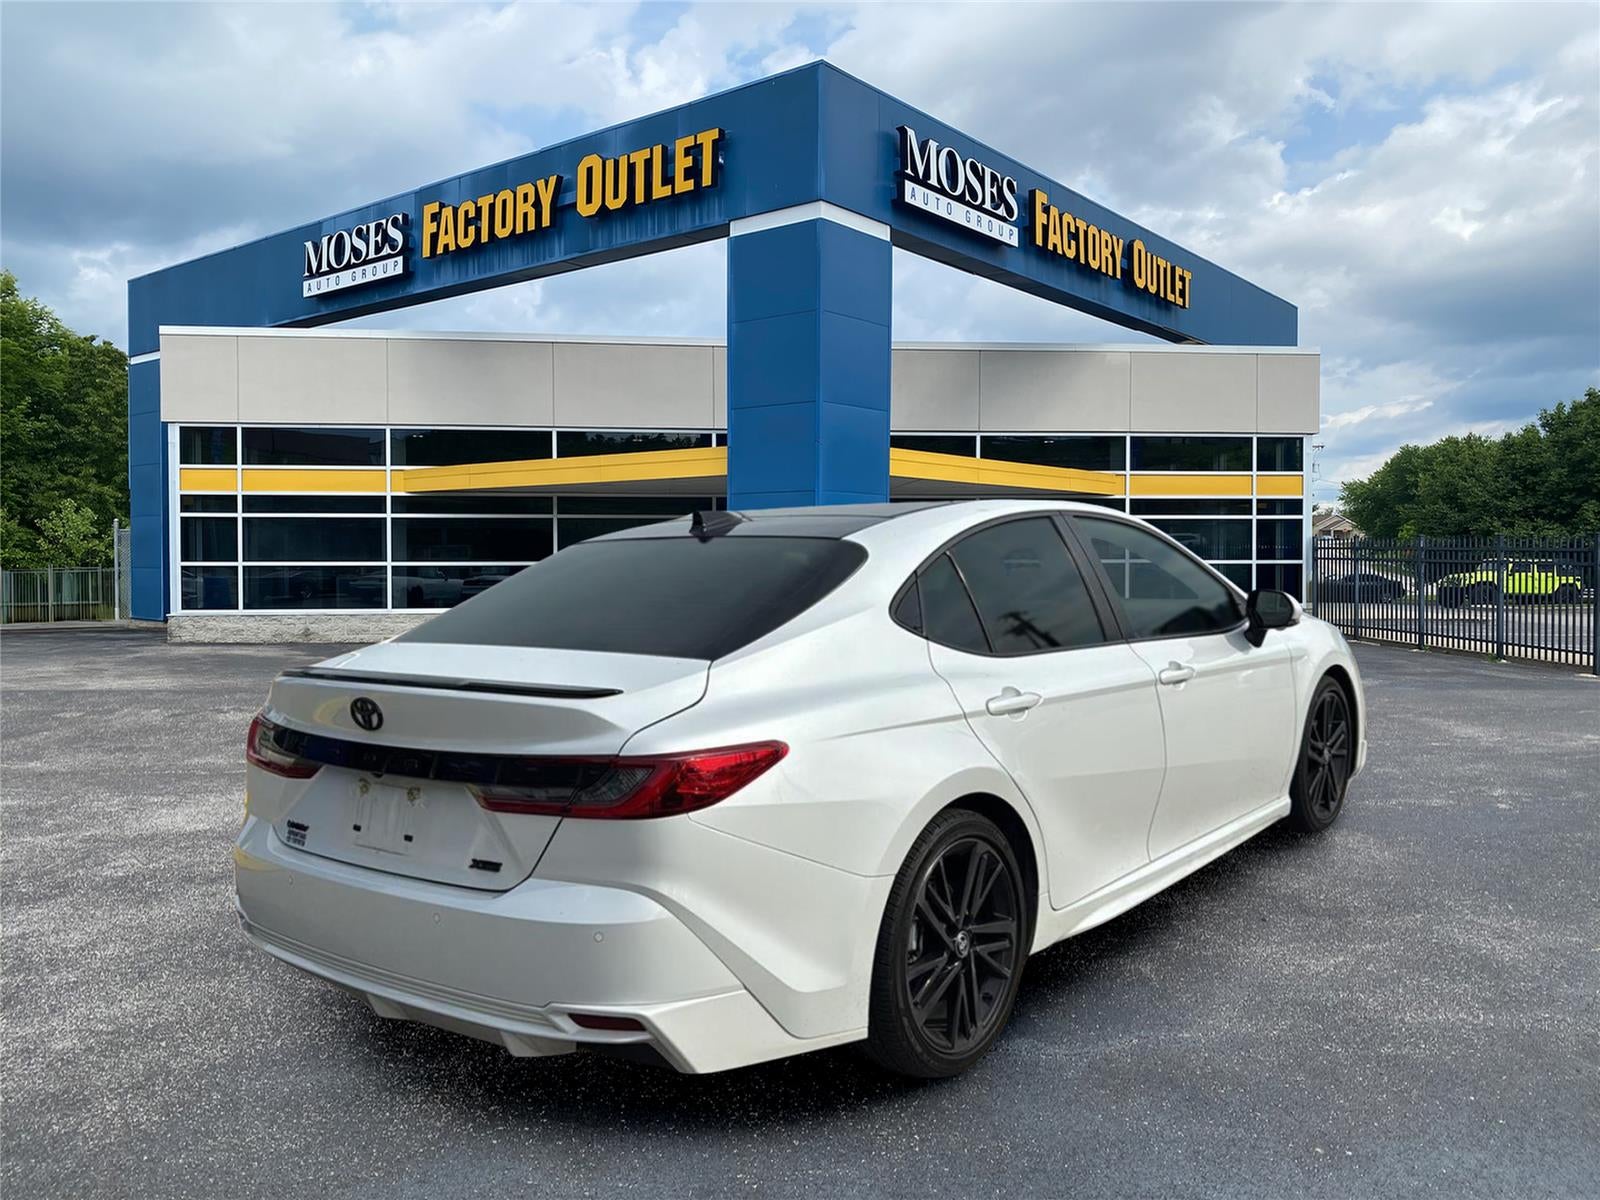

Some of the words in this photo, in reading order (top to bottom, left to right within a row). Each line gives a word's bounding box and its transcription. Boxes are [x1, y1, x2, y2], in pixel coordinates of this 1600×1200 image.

[422, 175, 560, 258] FACTORY
[577, 127, 720, 217] OUTLET
[904, 125, 1019, 221] MOSES
[303, 213, 403, 276] MOSES
[910, 187, 952, 215] AUTO
[965, 210, 1015, 240] GROUP
[1034, 188, 1124, 279] FACTORY
[1132, 239, 1192, 308] OUTLET
[307, 275, 340, 293] AUTO
[351, 260, 399, 281] GROUP
